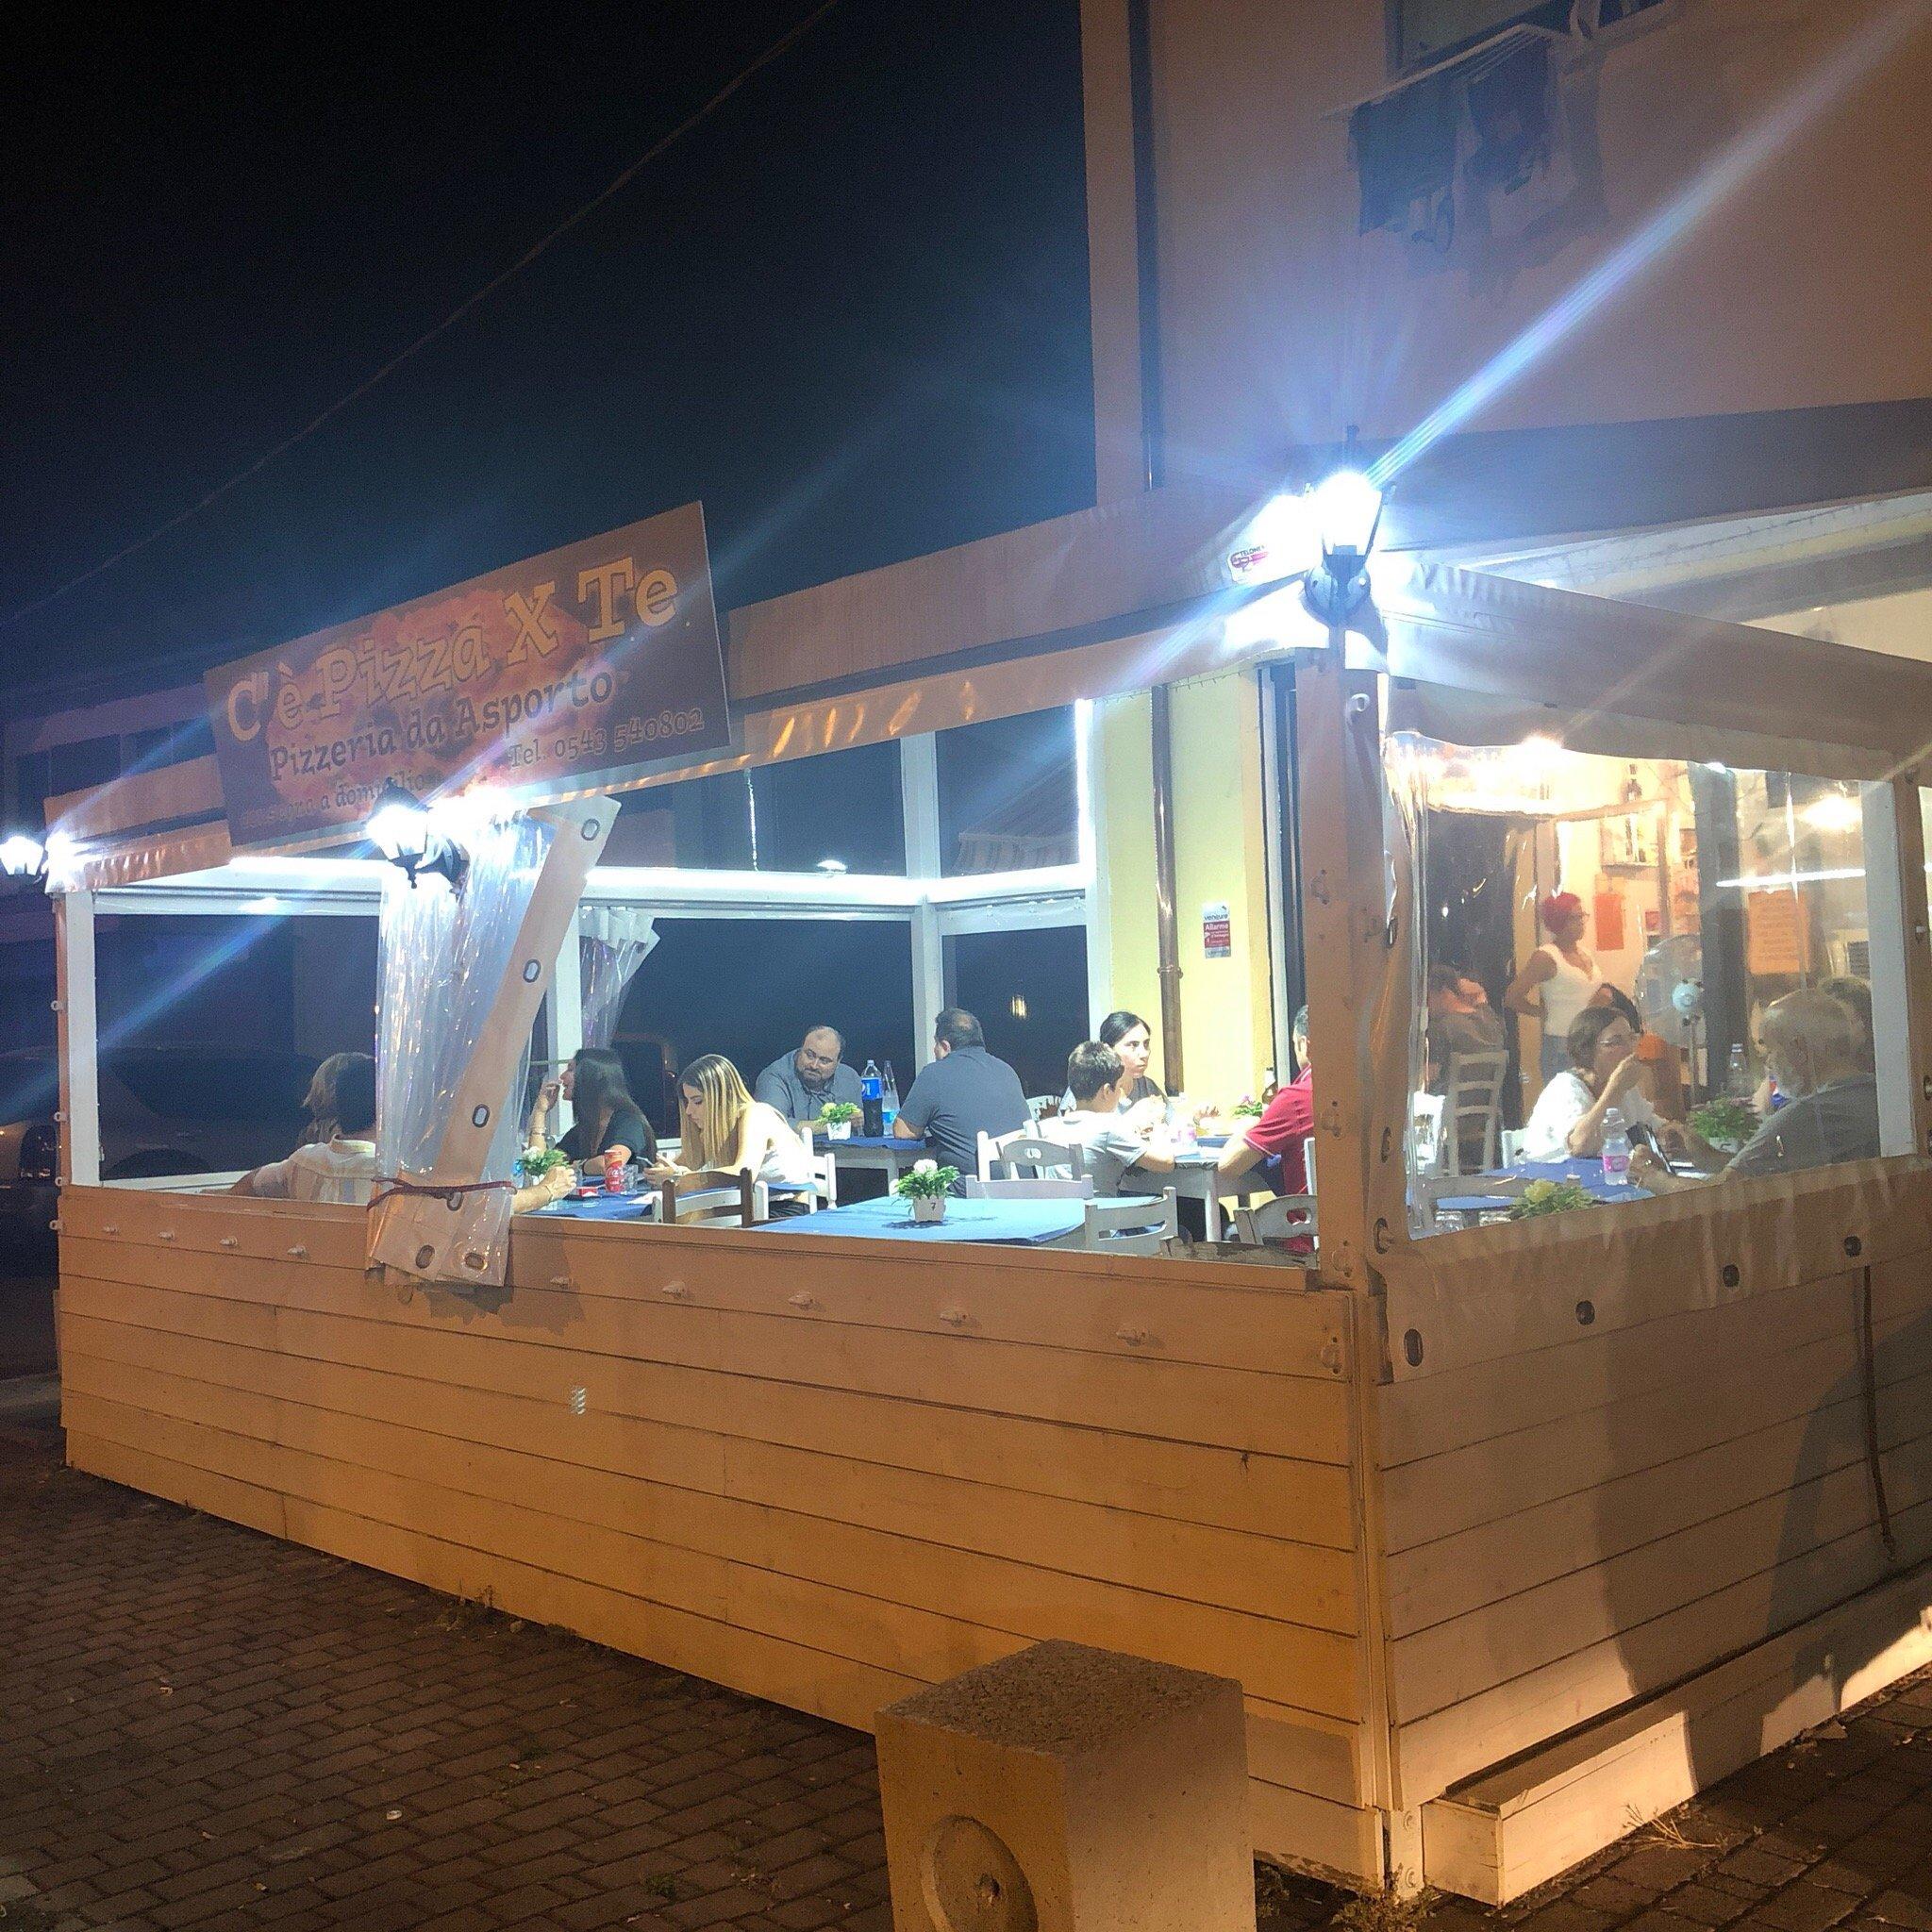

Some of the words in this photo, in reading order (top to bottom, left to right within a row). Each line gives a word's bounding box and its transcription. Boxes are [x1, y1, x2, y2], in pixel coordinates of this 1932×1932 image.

[315, 625, 491, 720] Pizza
[577, 557, 677, 643] Te
[270, 722, 397, 781] Pizzeria
[407, 708, 444, 747] da
[454, 671, 613, 739] Asporto
[508, 738, 546, 769] Tel.
[554, 727, 608, 761] 0543
[613, 707, 705, 753] 540802
[320, 794, 330, 810] a
[336, 769, 425, 808] domiilio
[1205, 923, 1229, 932] Allarme
